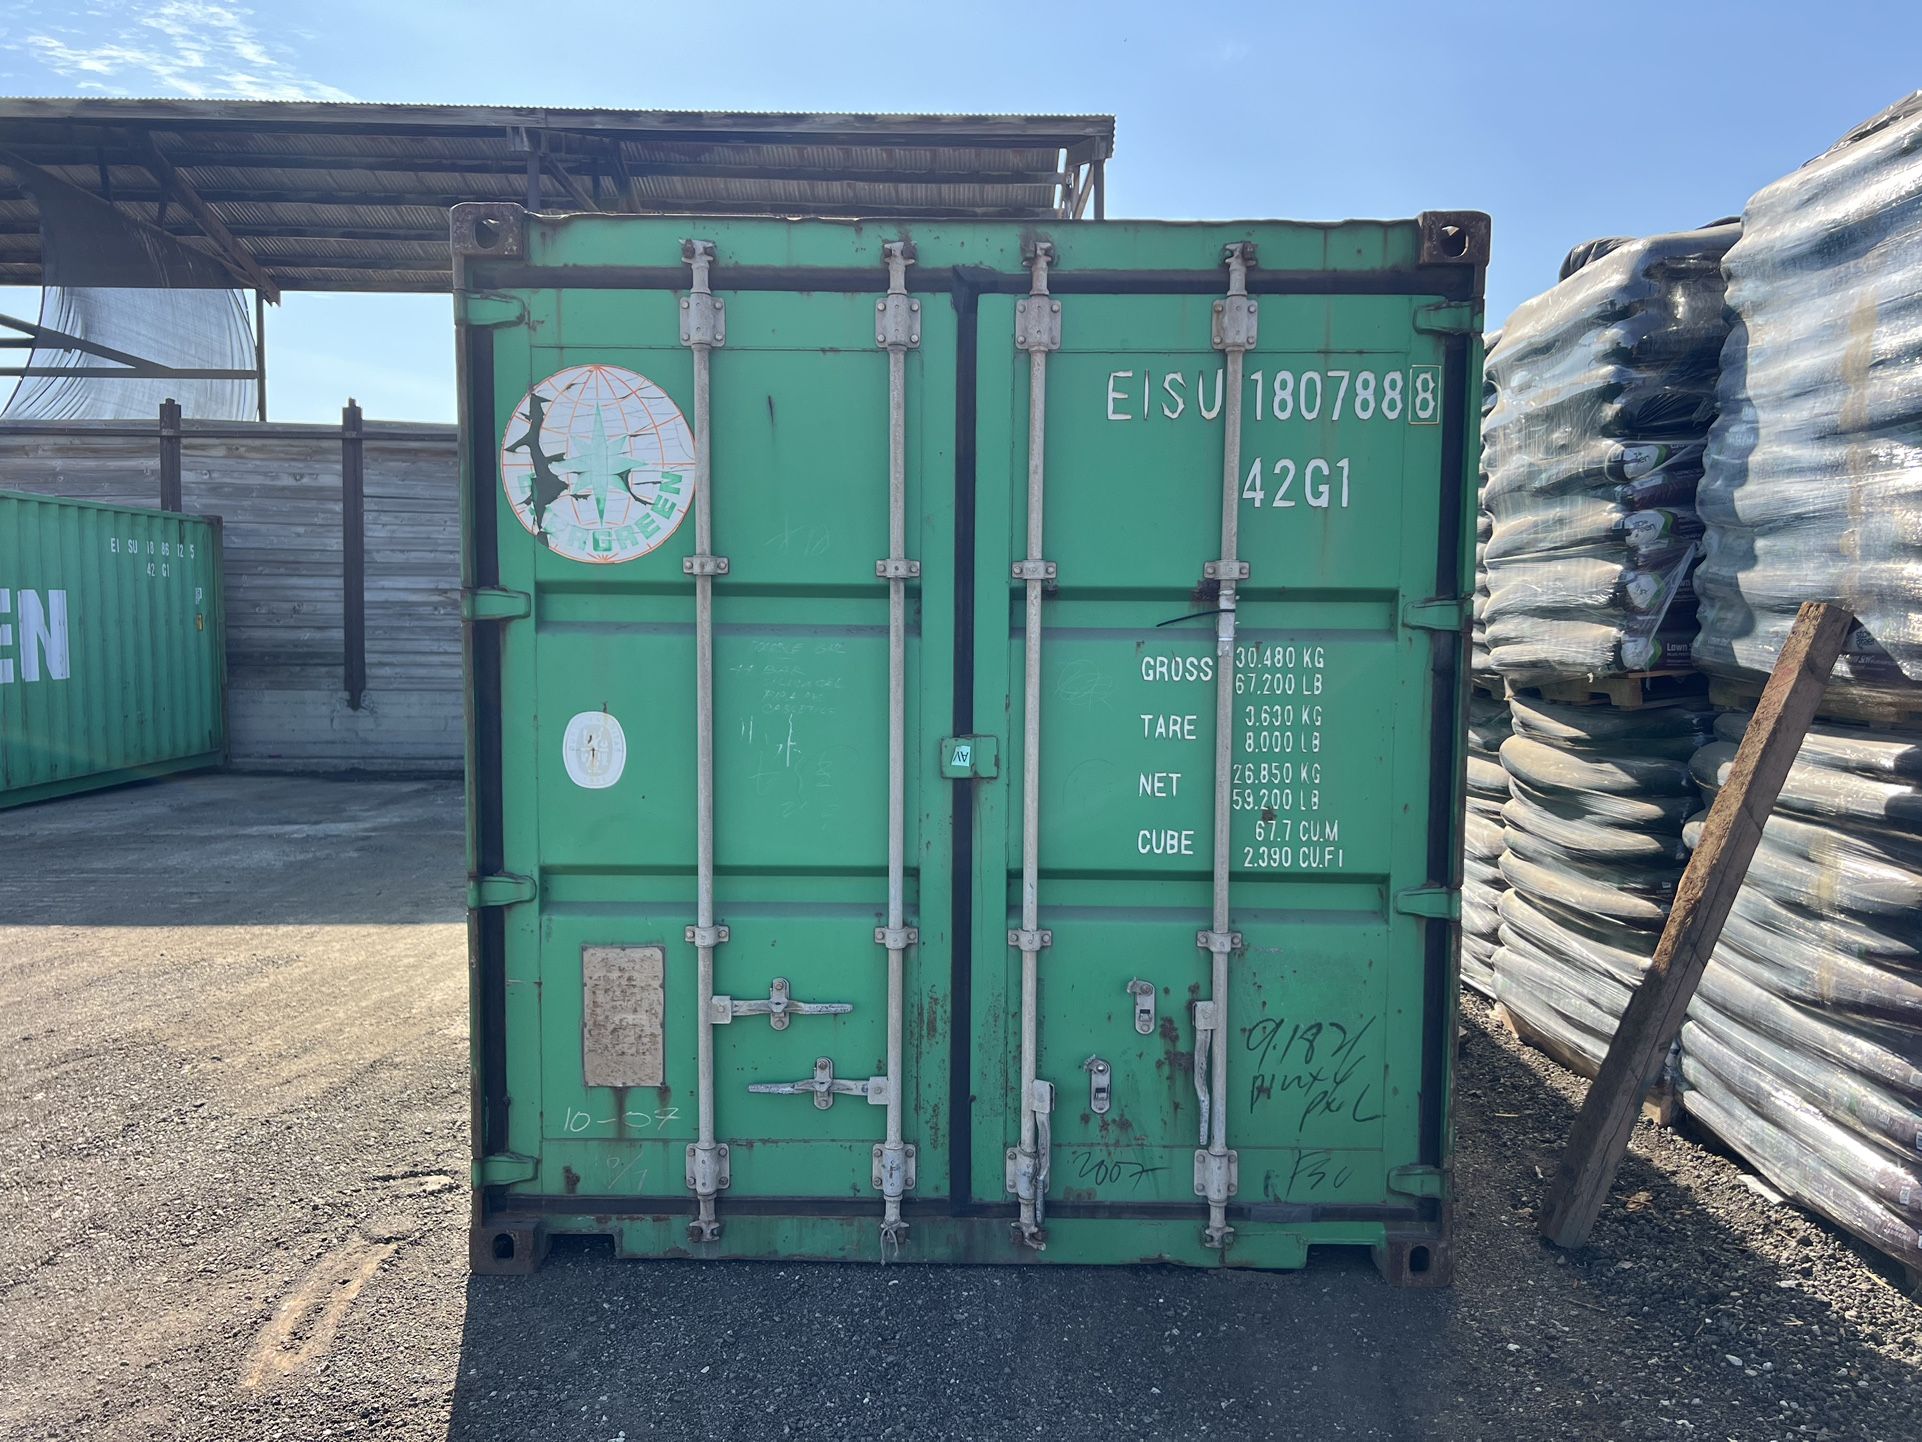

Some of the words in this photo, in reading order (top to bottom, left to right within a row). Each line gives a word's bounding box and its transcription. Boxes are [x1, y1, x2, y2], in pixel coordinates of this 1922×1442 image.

[1106, 368, 1224, 421] EISU
[1242, 457, 1350, 508] 42G1
[1235, 646, 1296, 669] 30.480
[1303, 646, 1325, 668] KG
[1666, 642, 1688, 652] Lawn
[1141, 656, 1214, 682] GROSS
[1235, 673, 1295, 695] 67.200
[1302, 673, 1323, 695] LB
[1140, 714, 1197, 740] TARE
[1245, 705, 1293, 727] 3.630
[1301, 704, 1322, 726] KG
[1244, 731, 1293, 752] 8.000
[1301, 731, 1321, 753] LB
[1232, 762, 1293, 784] 26.850
[1300, 762, 1321, 784] KG
[1138, 772, 1182, 798] NET
[1232, 788, 1292, 811] 59.200
[1299, 788, 1320, 810] LB
[1137, 829, 1195, 855] CUBE
[1255, 820, 1292, 842] 67.7
[1299, 819, 1339, 842] CU.M
[1243, 846, 1292, 868] 2.390
[1072, 1151, 1170, 1192] 2007
